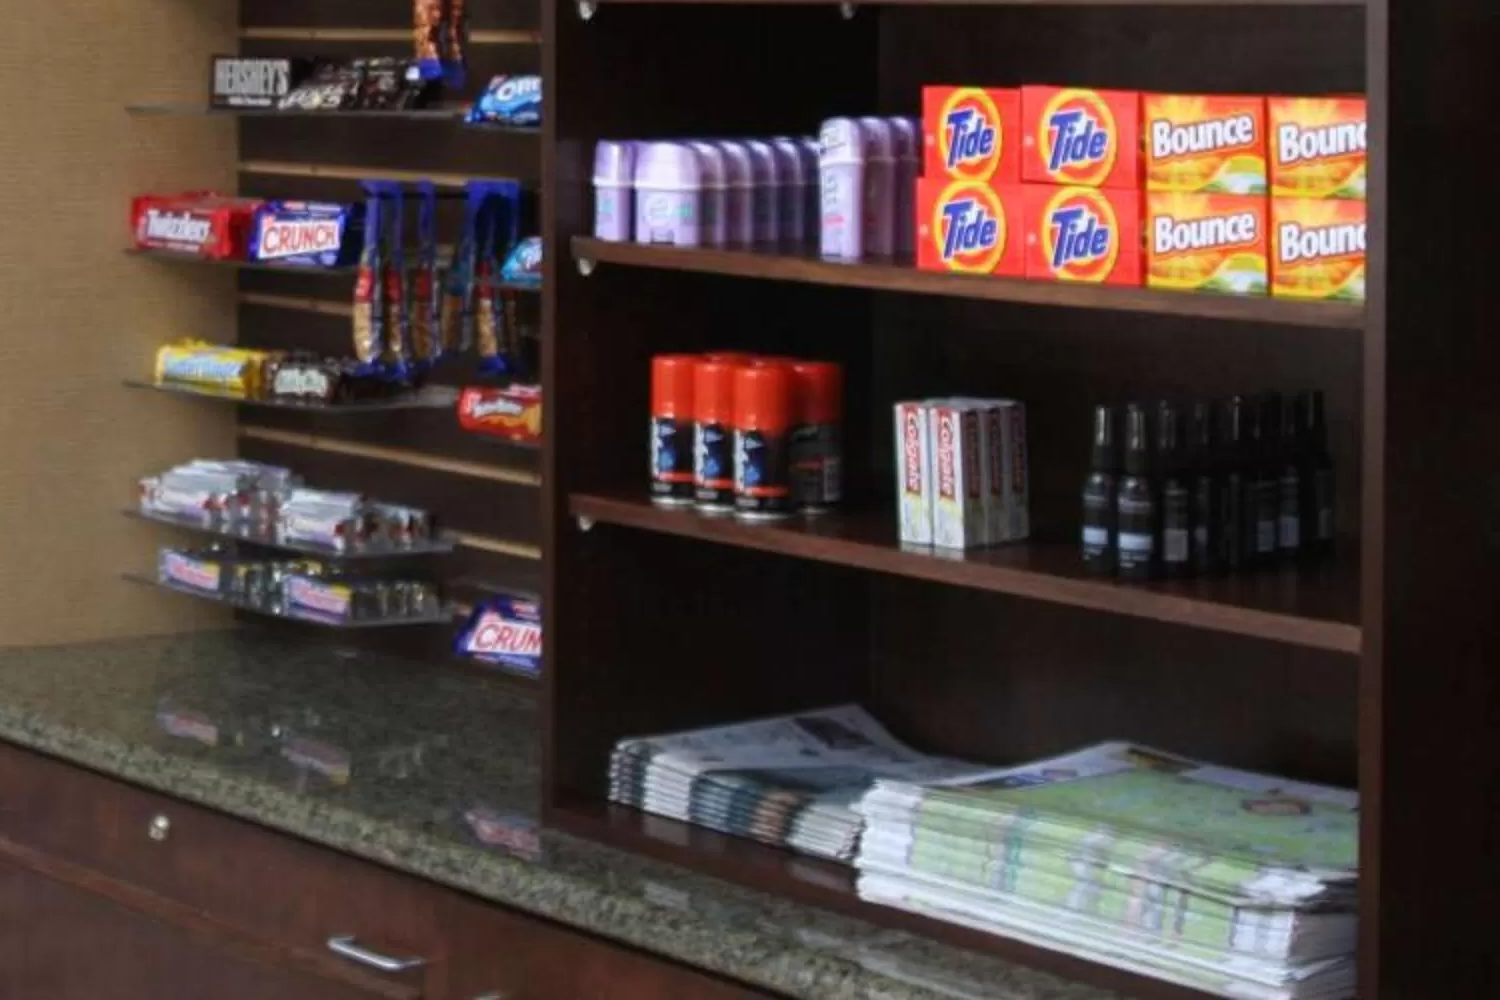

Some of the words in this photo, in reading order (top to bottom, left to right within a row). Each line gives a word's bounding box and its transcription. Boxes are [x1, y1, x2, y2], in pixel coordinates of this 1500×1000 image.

[947, 108, 995, 168] Tide
[1050, 110, 1108, 171] Tide
[1152, 115, 1253, 158] Bounce
[1279, 119, 1367, 163] Bounc
[263, 224, 336, 254] CRUNCH
[943, 200, 997, 259] Tide
[1052, 208, 1109, 268] Tide
[1154, 213, 1255, 253] Bounce
[1280, 223, 1367, 262] Bounc
[475, 623, 542, 652] CRUN
